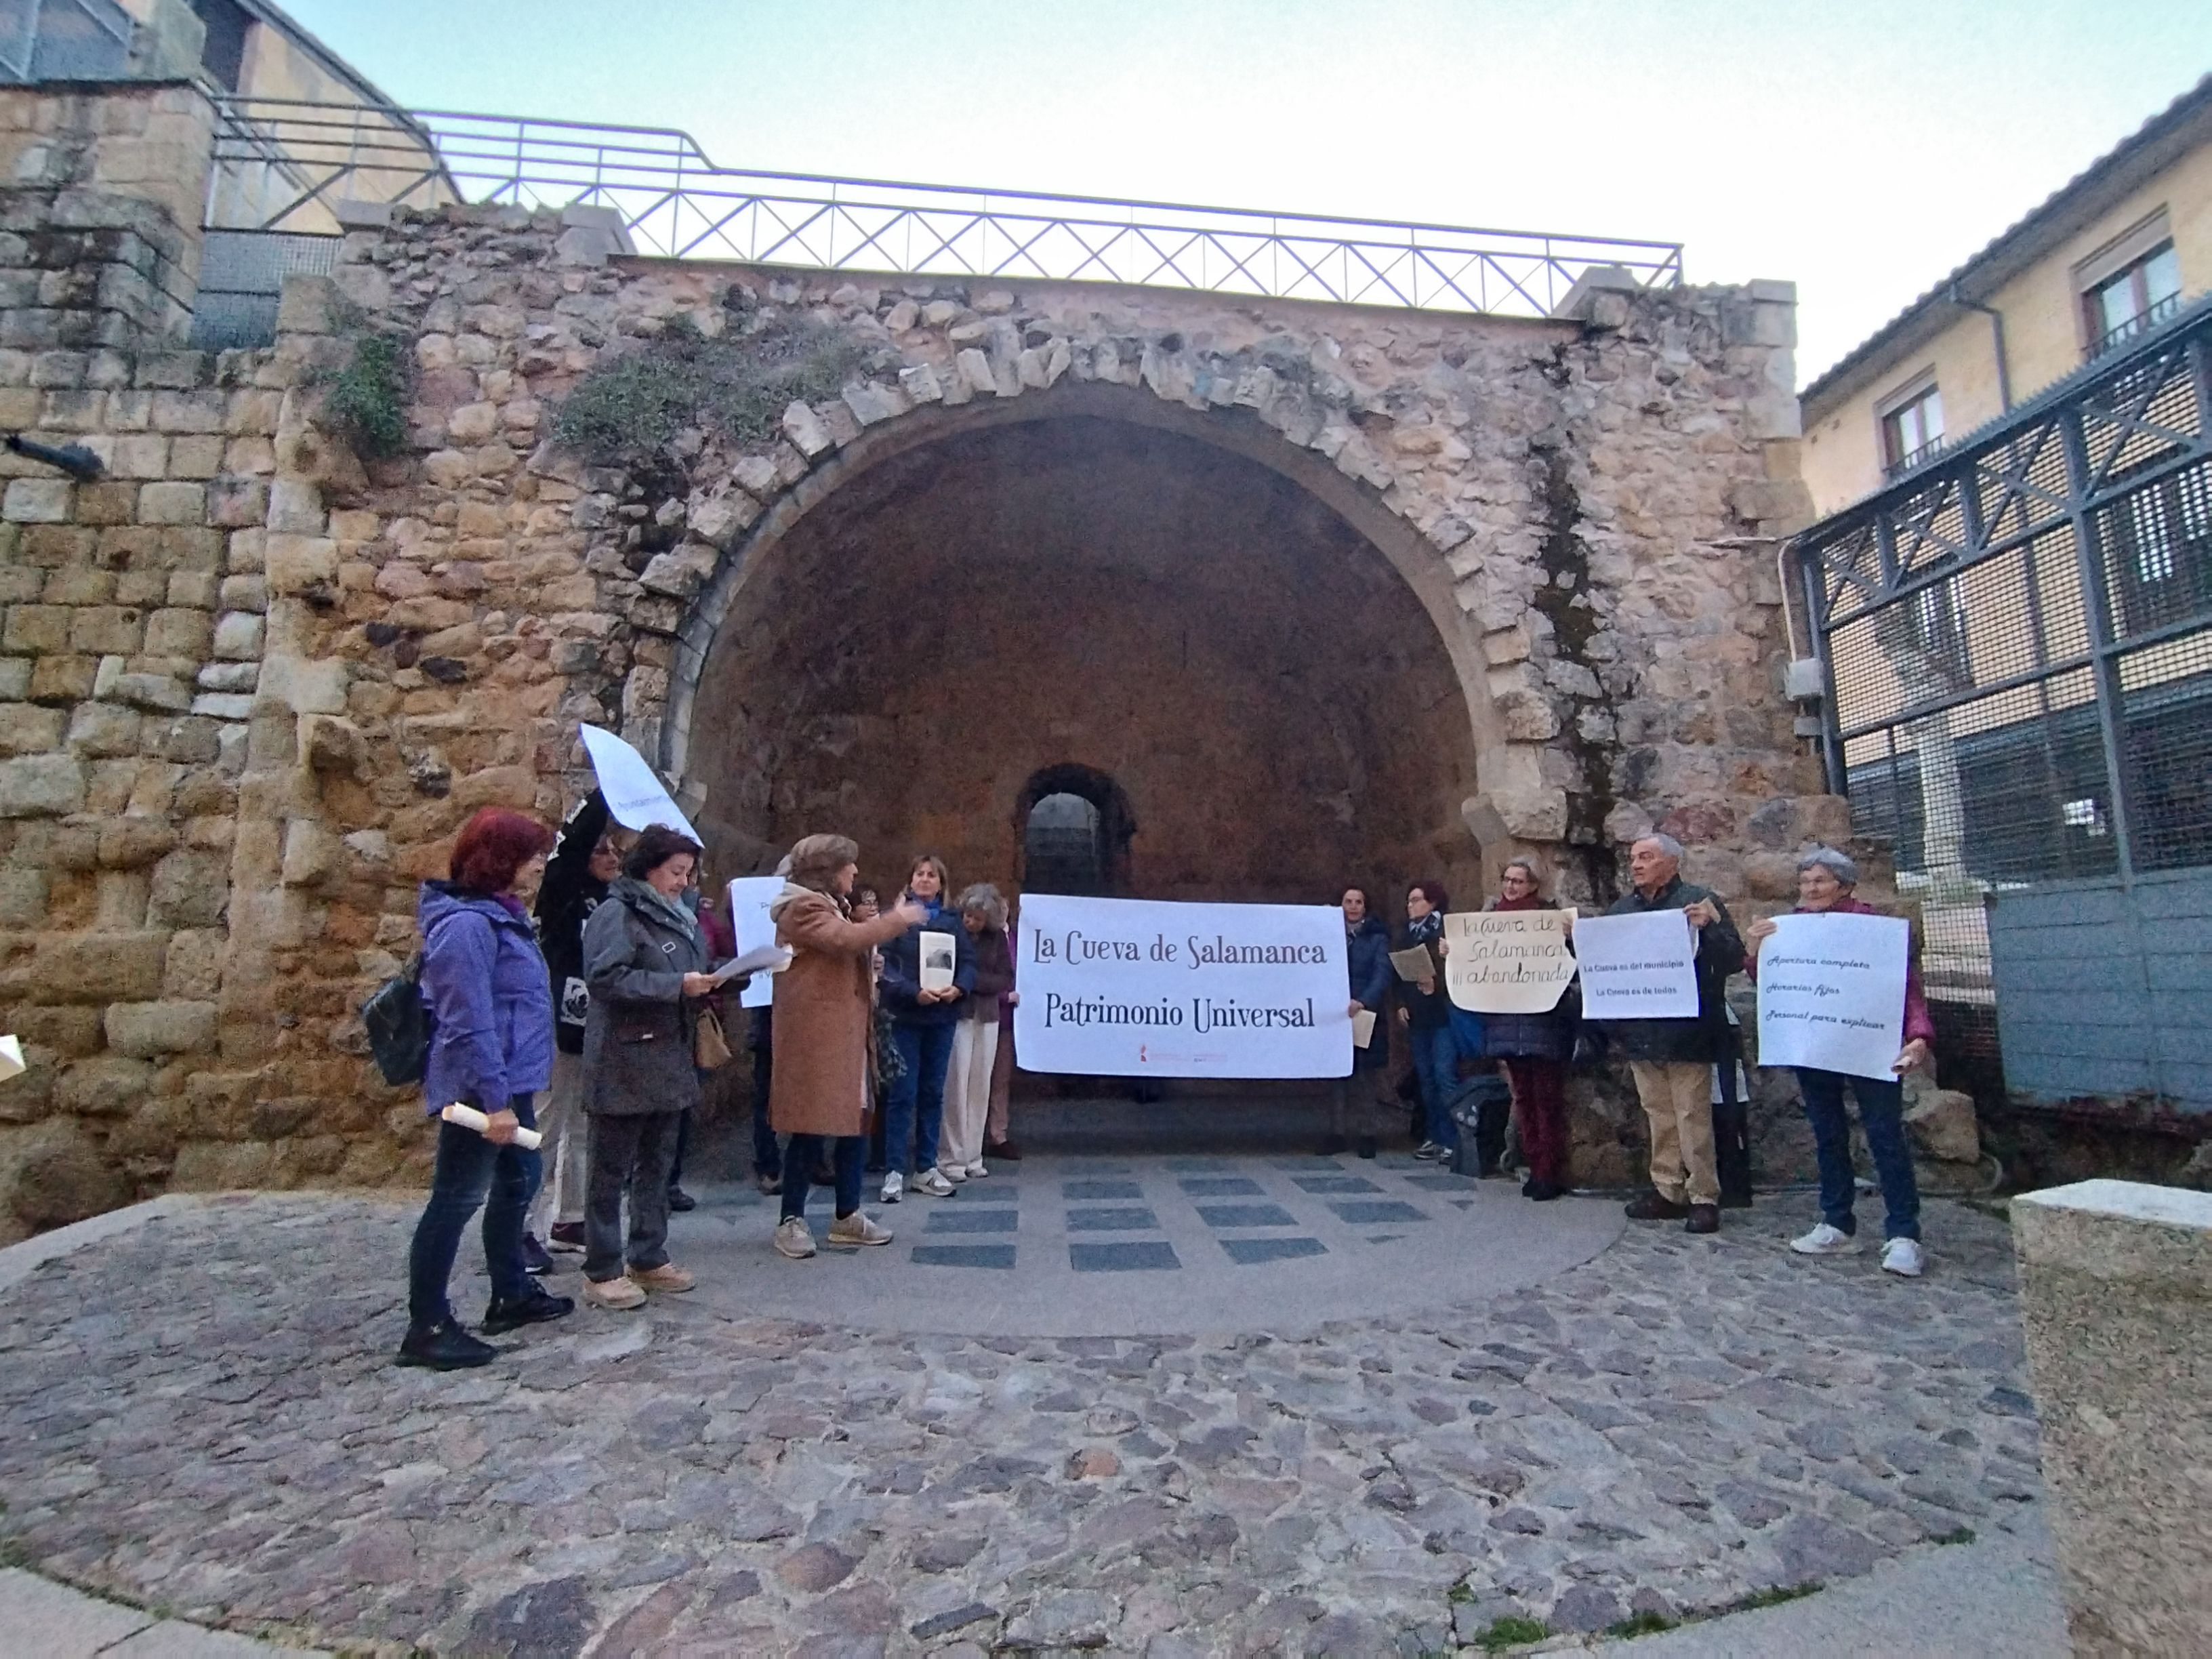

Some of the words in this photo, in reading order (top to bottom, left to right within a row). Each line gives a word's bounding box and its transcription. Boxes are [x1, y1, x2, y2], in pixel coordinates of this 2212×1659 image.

[1533, 915, 1556, 933] de
[1033, 929, 1057, 964] La
[1066, 930, 1141, 965] Cueva
[1149, 933, 1177, 962] de
[1187, 935, 1327, 969] Salamanca
[1584, 965, 1593, 973] La
[1594, 964, 1618, 972] Cueva
[1630, 962, 1642, 970] del
[1644, 960, 1684, 970] municipio
[1767, 956, 1817, 967] Apertura
[1820, 959, 1870, 970] completa
[1596, 989, 1605, 997] La
[1607, 988, 1630, 997] Cueva
[1654, 986, 1677, 995] todos
[1767, 984, 1812, 994] Horarios
[1044, 993, 1183, 1028] Patrimonio
[1193, 998, 1315, 1033] Universal
[1766, 1009, 1809, 1021] Personal
[1810, 1015, 1837, 1024] para
[1841, 1018, 1885, 1030] explicar
